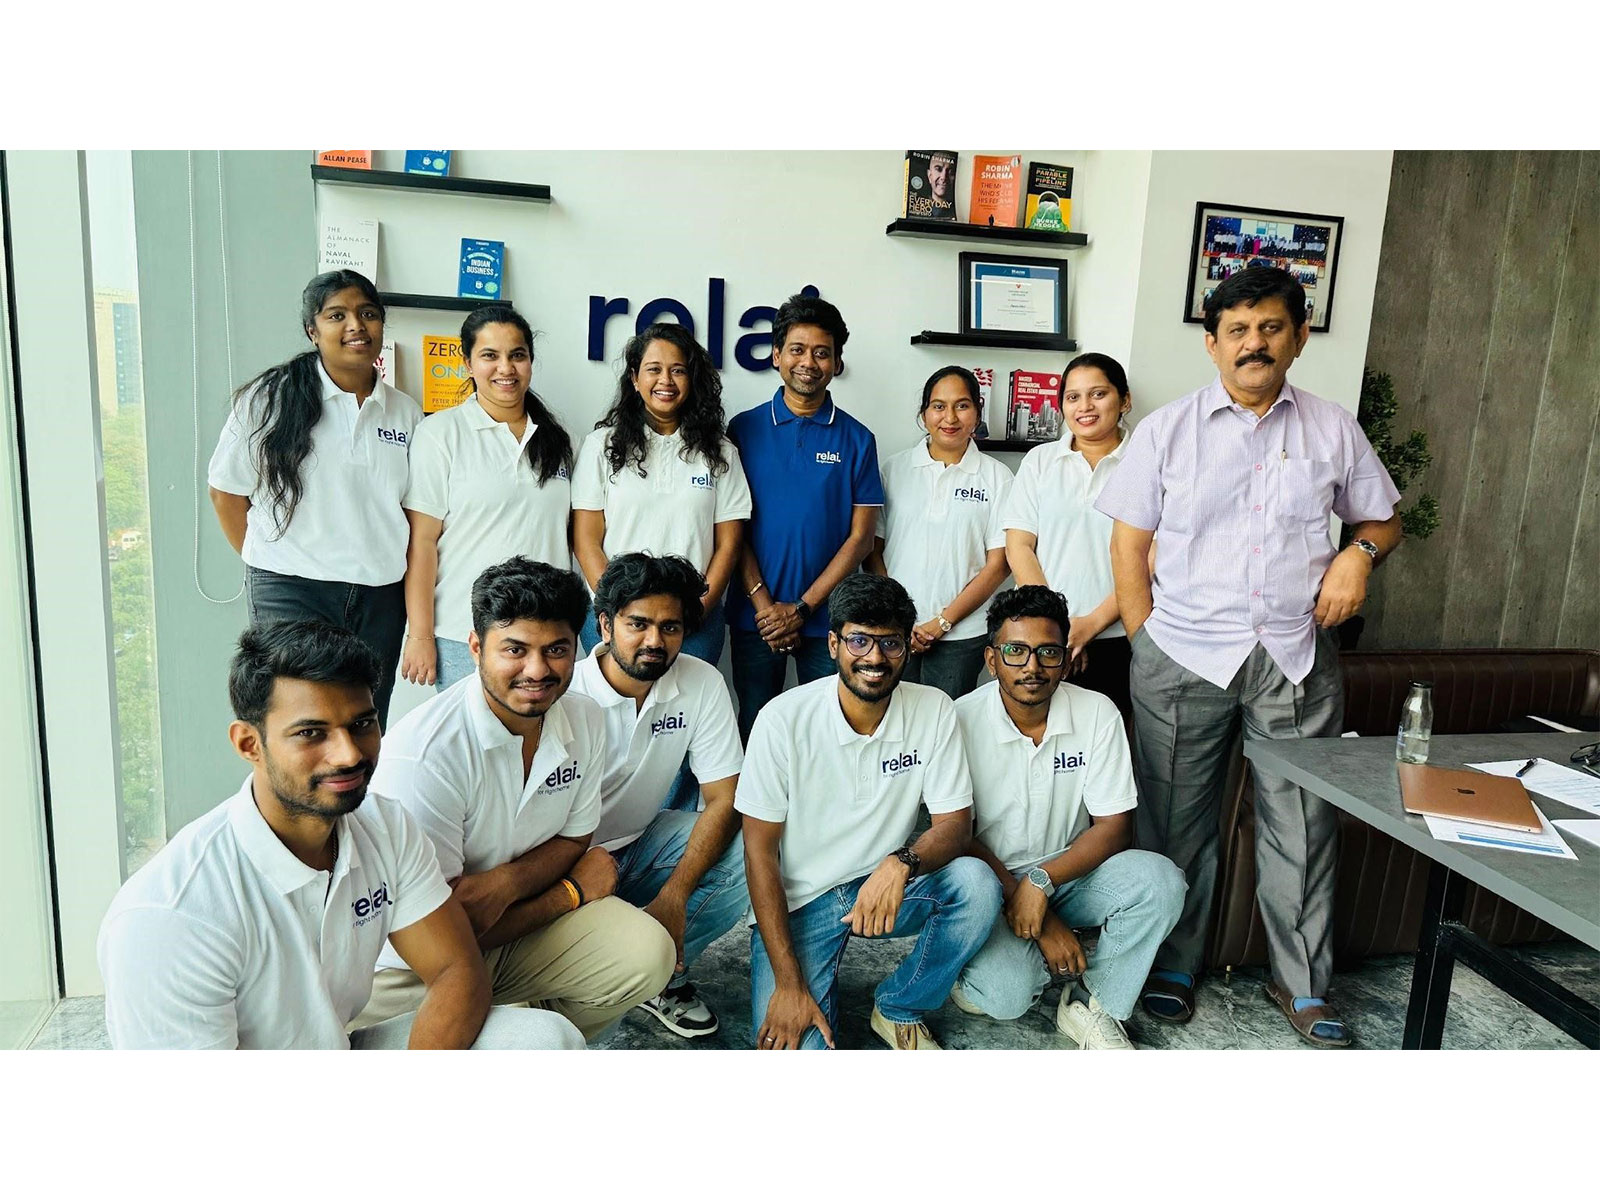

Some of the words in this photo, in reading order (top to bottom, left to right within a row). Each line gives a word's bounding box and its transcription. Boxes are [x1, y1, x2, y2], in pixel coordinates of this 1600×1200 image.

[323, 154, 345, 162] ALLAN
[347, 155, 367, 164] PEASE
[913, 152, 930, 160] ROBIN
[985, 164, 1010, 172] ROBIN
[1036, 169, 1067, 178] PARABLE
[981, 172, 1013, 180] SHARMA
[1036, 178, 1067, 187] PIPELINE
[909, 202, 933, 213] HERO
[910, 195, 952, 209] EVERYDAY
[327, 235, 370, 243] ALMANACK
[325, 259, 364, 267] RAVIKANT
[471, 259, 491, 268] INDIAN
[467, 265, 494, 276] BUSINESS
[431, 364, 467, 379] ONE
[816, 451, 841, 463] relai.
[955, 487, 988, 502] relai.
[882, 749, 922, 774] relai.
[1054, 751, 1086, 769] elai.
[545, 760, 581, 788] elai.
[351, 881, 393, 917] elai.
